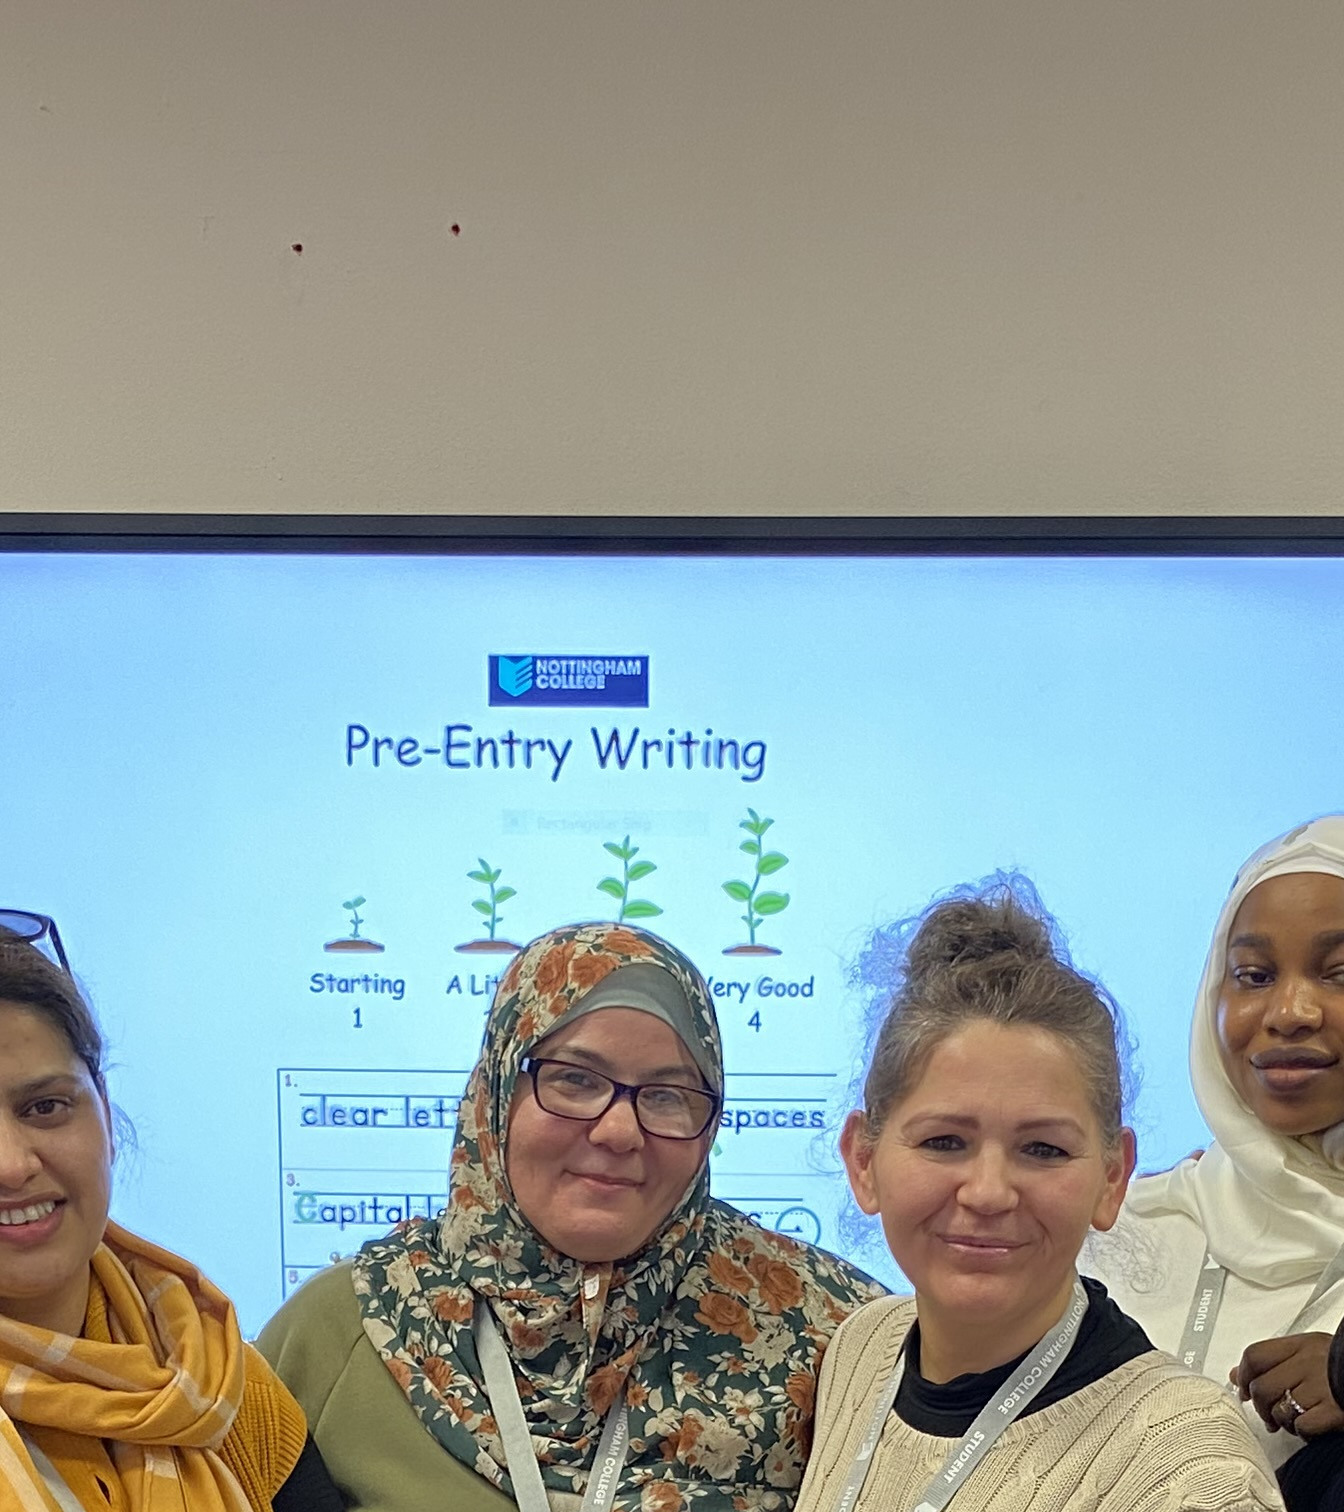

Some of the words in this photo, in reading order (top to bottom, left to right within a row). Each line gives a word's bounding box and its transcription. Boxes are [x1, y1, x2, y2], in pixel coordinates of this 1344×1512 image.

[535, 660, 642, 675] NOTTINGHAM
[535, 674, 606, 690] COLLEGE
[346, 723, 573, 782] Pre-Entry
[591, 725, 767, 782] Writing
[310, 972, 406, 1001] Starting
[446, 974, 463, 995] A
[758, 975, 814, 998] Good
[353, 1008, 363, 1030] 1
[748, 1011, 762, 1033] 4
[302, 1095, 387, 1126] clear
[720, 1110, 824, 1135] spaces
[1194, 1289, 1213, 1332] STUDENT
[1039, 1296, 1087, 1369] NOTTINGHAM
[998, 1367, 1042, 1415] COLLEGE
[946, 1430, 985, 1484] STUDENT
[594, 1457, 617, 1506] COLLEGE
